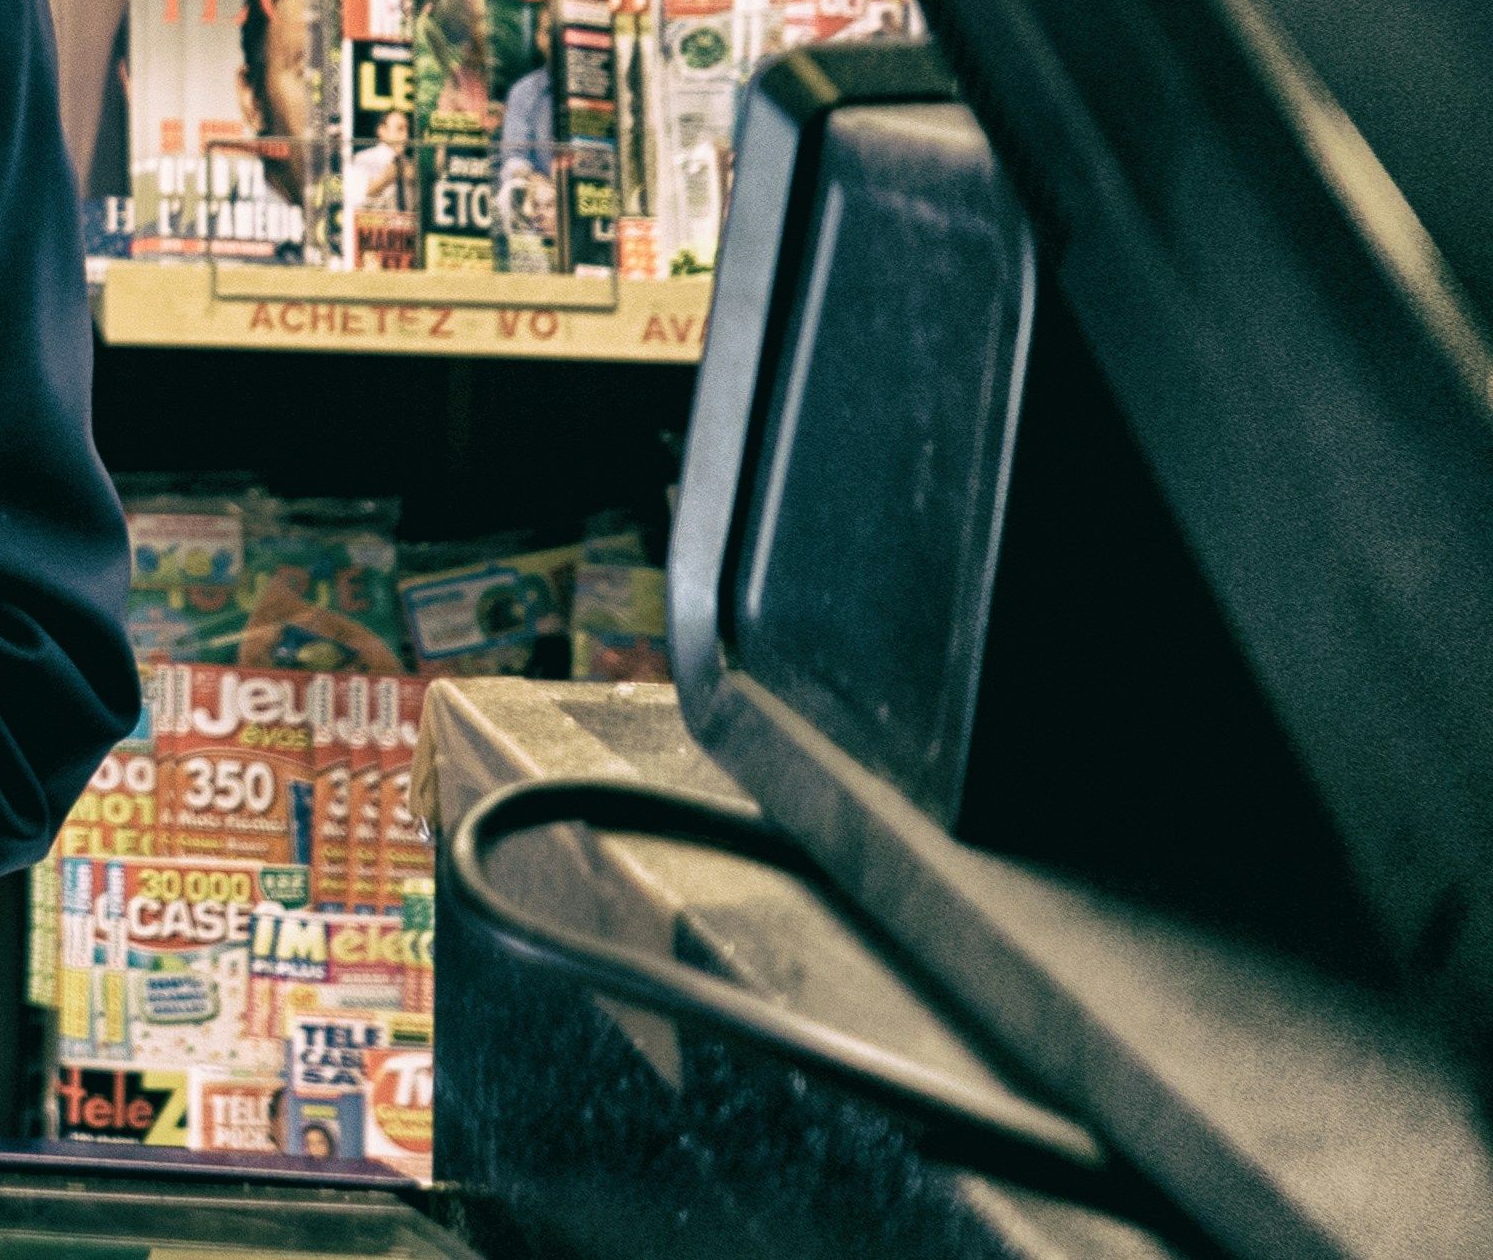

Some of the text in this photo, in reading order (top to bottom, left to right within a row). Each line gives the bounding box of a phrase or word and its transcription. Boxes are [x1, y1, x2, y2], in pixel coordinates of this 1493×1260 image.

[249, 302, 455, 342] ACHETEZ
[184, 756, 277, 813] 350
[127, 895, 285, 941] CASE
